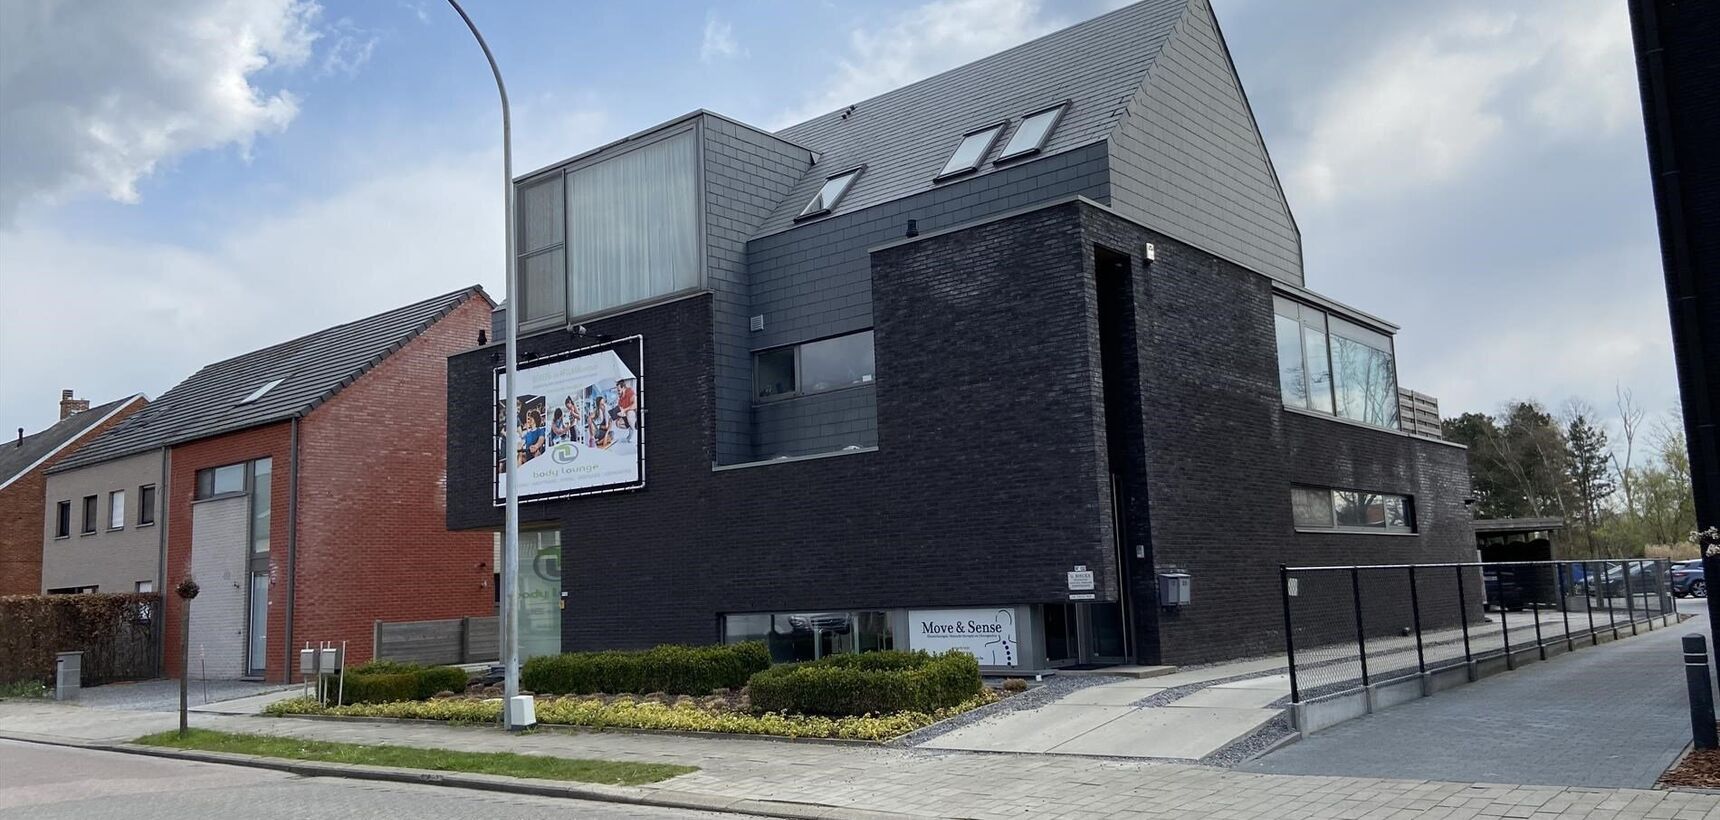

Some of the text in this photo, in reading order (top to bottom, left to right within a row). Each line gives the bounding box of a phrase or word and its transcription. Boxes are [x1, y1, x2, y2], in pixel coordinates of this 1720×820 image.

[533, 470, 558, 479] body
[561, 464, 600, 474] lounge
[921, 620, 1002, 634] Move & Sense
